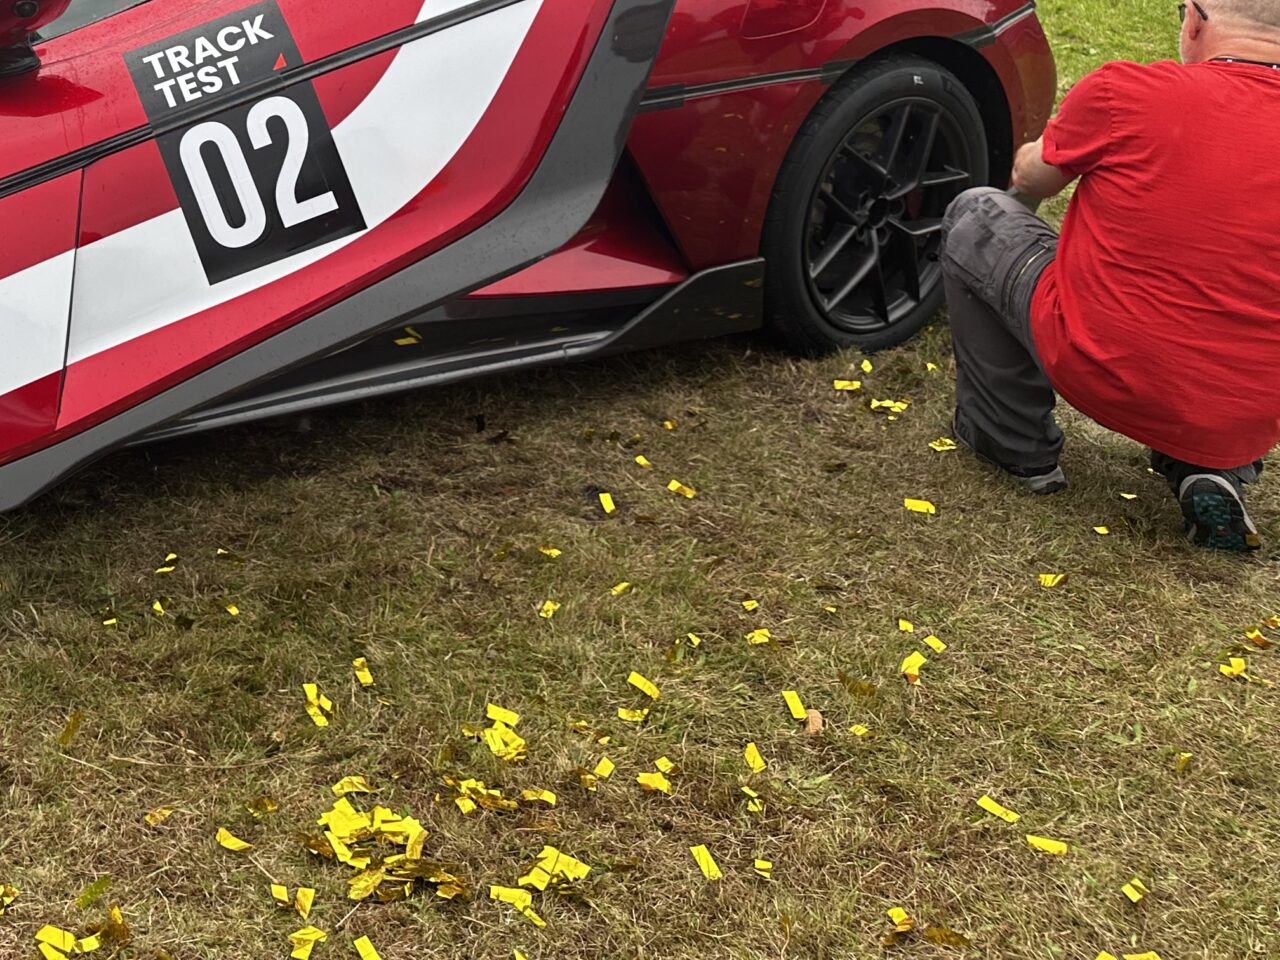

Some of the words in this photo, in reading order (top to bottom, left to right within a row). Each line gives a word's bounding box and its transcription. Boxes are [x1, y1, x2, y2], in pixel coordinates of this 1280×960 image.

[143, 14, 274, 78] TRACK
[153, 57, 240, 108] TEST
[179, 96, 339, 248] 02
